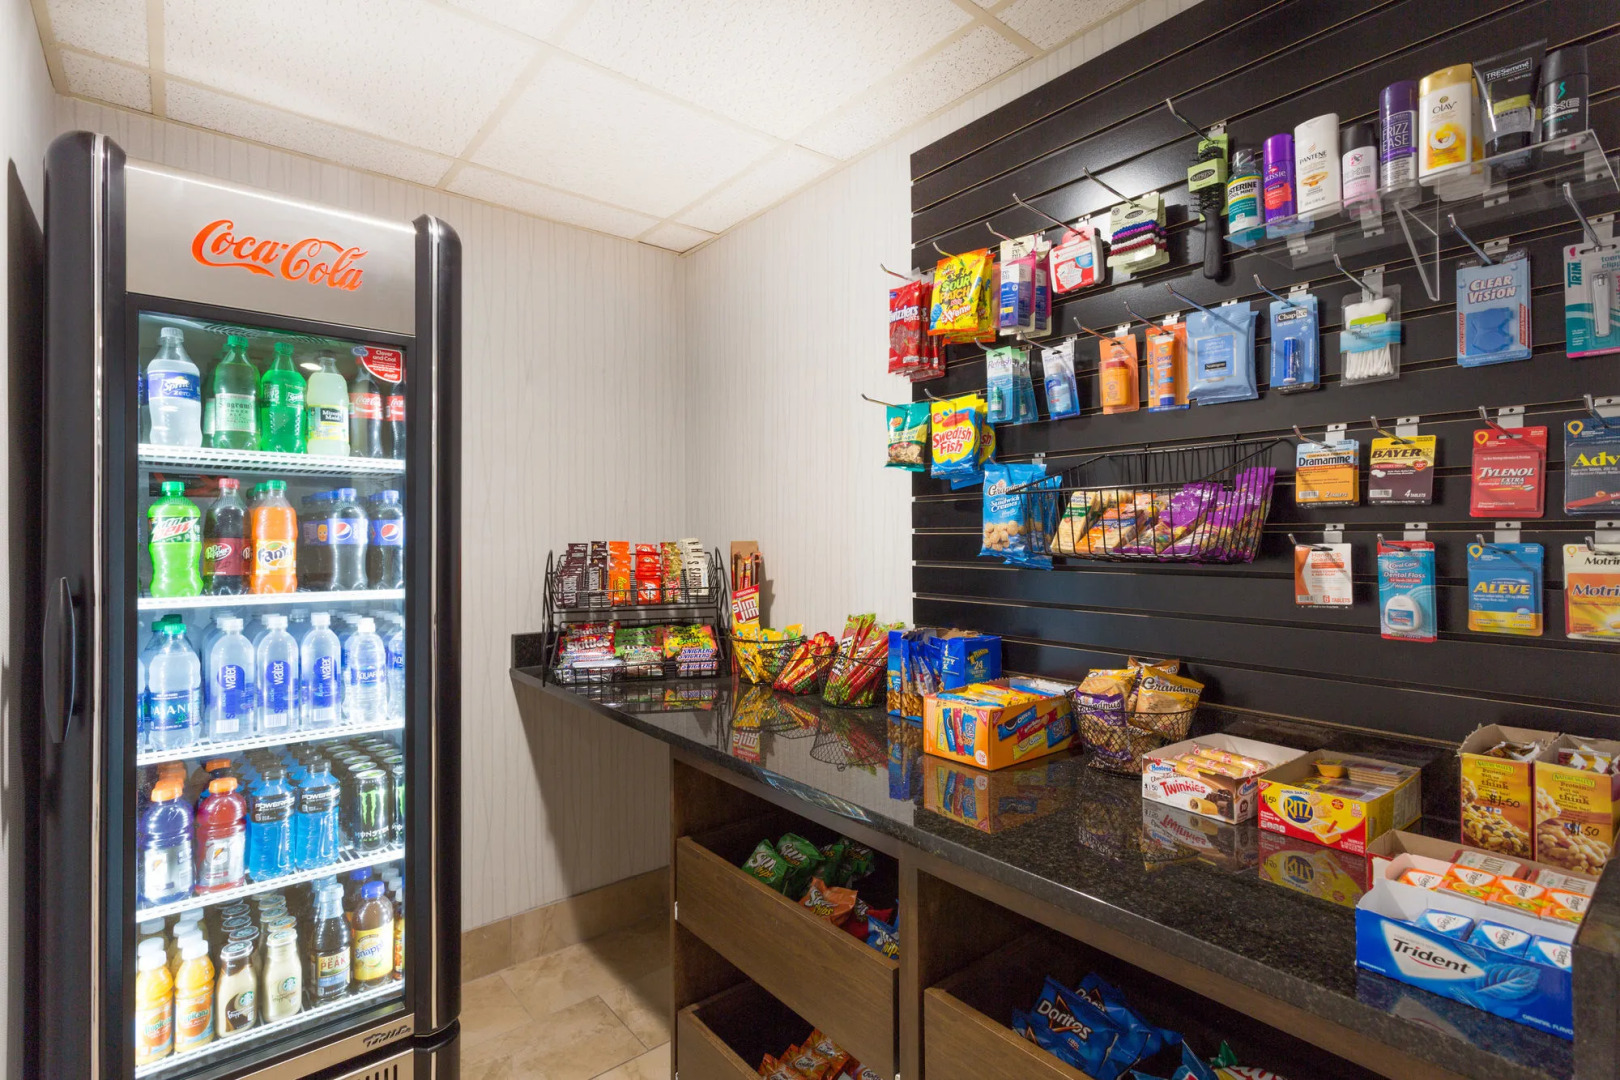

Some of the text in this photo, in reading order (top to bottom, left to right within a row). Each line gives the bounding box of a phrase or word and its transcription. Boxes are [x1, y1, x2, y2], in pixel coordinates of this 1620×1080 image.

[1432, 101, 1457, 114] OLAY
[1382, 122, 1409, 141] FRIZZ
[1382, 134, 1409, 153] EASE
[1299, 149, 1328, 165] PANTENE
[1240, 188, 1254, 196] MINT
[191, 219, 368, 291] Coca-Cola
[1568, 261, 1582, 288] TRIM
[941, 275, 971, 292] SOUR
[1470, 275, 1513, 292] CLEAR
[940, 287, 971, 304] PATCH
[988, 358, 1012, 369] Refresh
[932, 427, 973, 448] Swedish
[939, 440, 964, 455] Fish
[1372, 448, 1422, 458] BAYER
[1298, 455, 1351, 467] Dramamine
[1571, 451, 1620, 467] Adv
[1477, 467, 1535, 479] TYLENOL
[1404, 490, 1411, 498] 4
[990, 496, 1020, 508] Sandwich
[991, 502, 1018, 513] Cremes
[206, 548, 230, 560] Pepper
[734, 587, 756, 597] ORIGINAL
[1473, 581, 1531, 595] ALEVE
[732, 597, 757, 614] slim
[1323, 595, 1330, 603] 6
[738, 606, 759, 624] jim
[566, 638, 611, 652] Skittles
[681, 647, 715, 655] SNICKERS
[677, 653, 712, 661] SNICKERS
[974, 660, 983, 669] 24
[271, 661, 284, 685] water
[320, 657, 331, 680] water
[225, 665, 237, 690] water
[1141, 676, 1201, 696] Grandma's
[1151, 763, 1172, 773] Hostess
[1159, 776, 1206, 797] Twinkies
[1481, 780, 1509, 790] think
[1560, 782, 1587, 790] Protein
[1490, 794, 1520, 808] $1.50
[1555, 802, 1578, 810] Protein
[1559, 794, 1590, 805] think
[1284, 796, 1313, 819] RITZ
[354, 825, 389, 838] MONSTER
[1469, 871, 1483, 886] Trident
[1519, 882, 1532, 898] Trident
[1499, 929, 1514, 946] Trident
[355, 941, 386, 959] Snapp
[1393, 939, 1470, 974] Trident
[320, 958, 346, 970] PEAK
[1037, 998, 1093, 1041] Doritos
[1522, 1013, 1550, 1028] ORIGINAL
